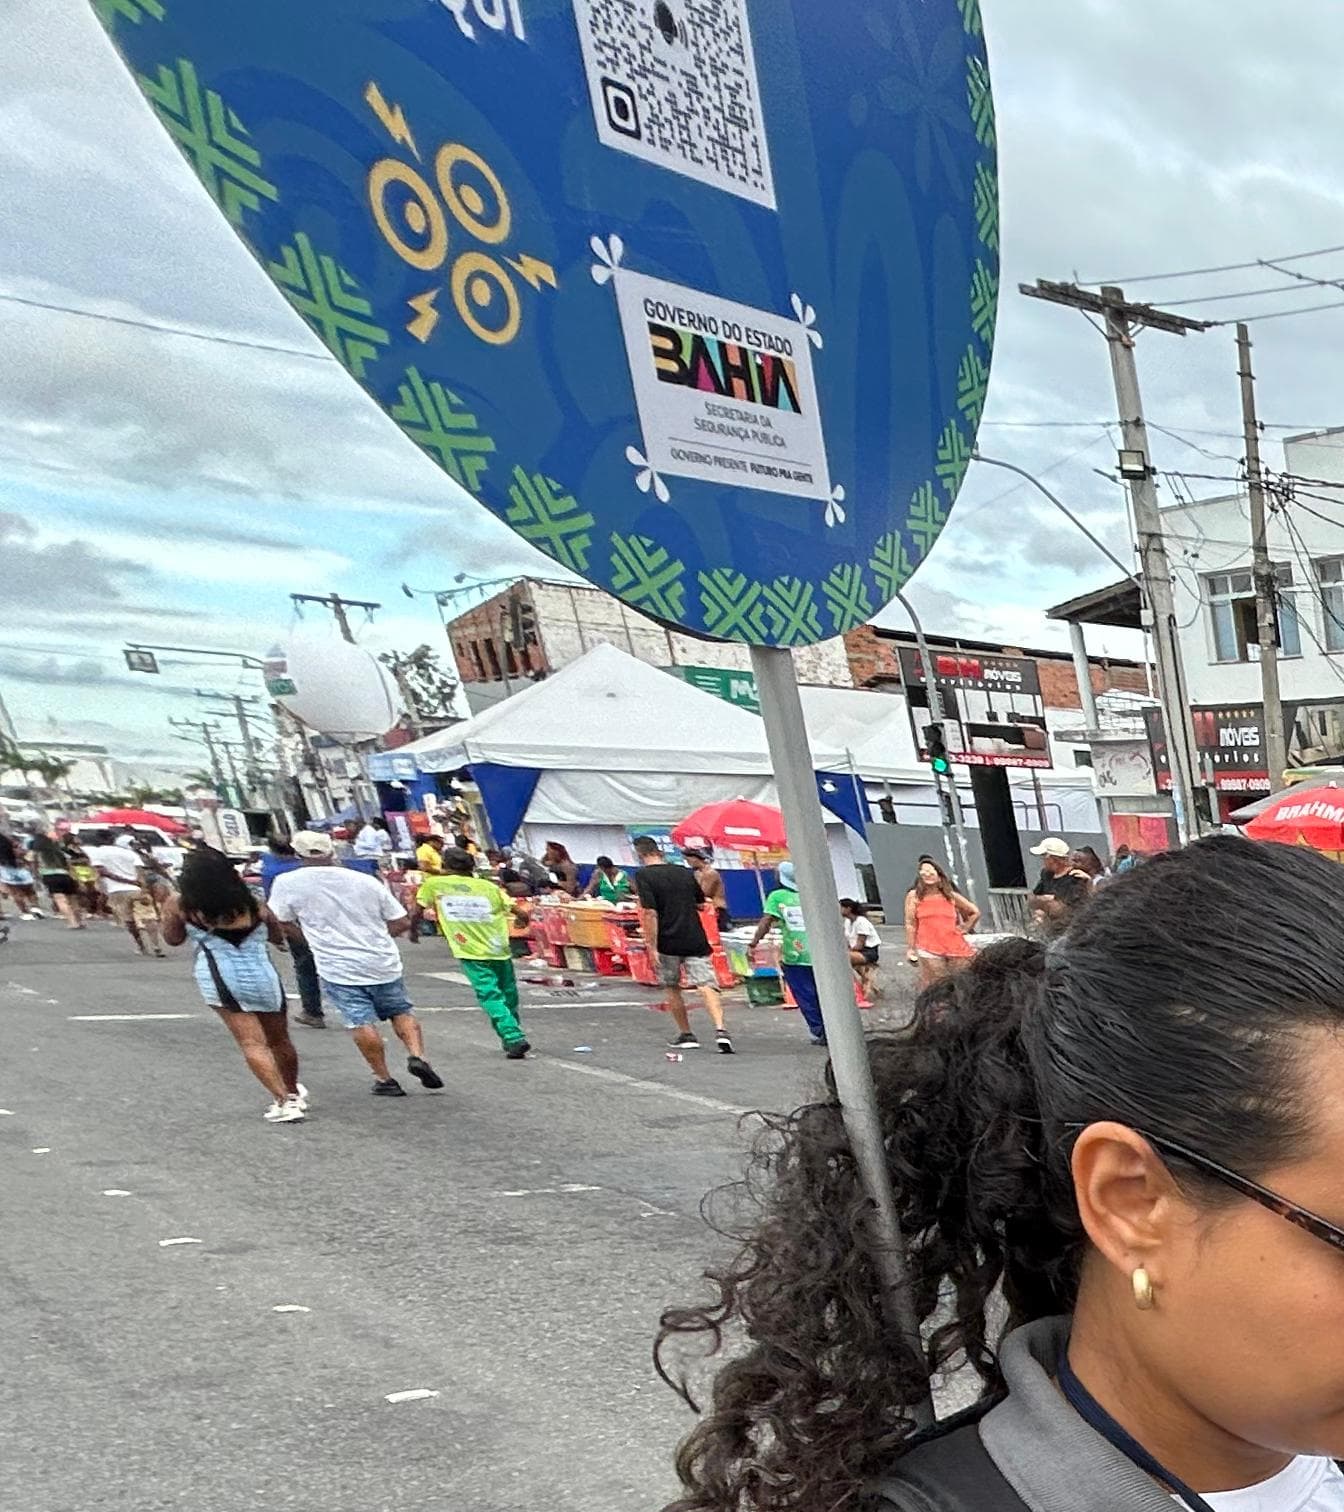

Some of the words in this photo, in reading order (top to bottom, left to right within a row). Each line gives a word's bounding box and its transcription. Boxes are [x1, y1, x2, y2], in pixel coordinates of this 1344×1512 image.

[644, 298, 719, 336] GOVERNO
[722, 320, 742, 342] DO
[746, 328, 793, 357] ESTADO
[648, 321, 802, 415] BAHIA
[704, 401, 759, 426] SECRETARIA
[760, 415, 773, 430] DA
